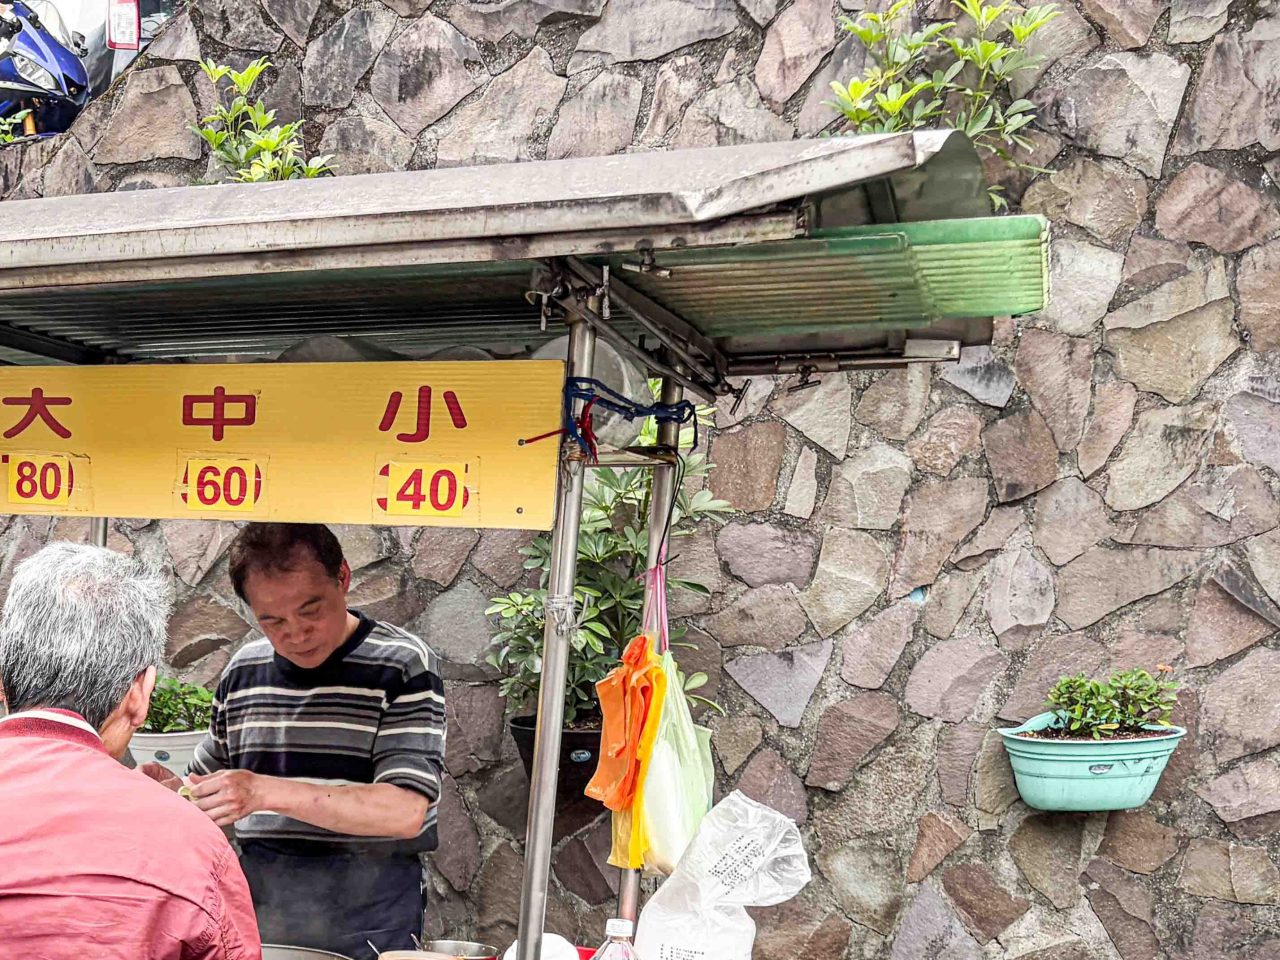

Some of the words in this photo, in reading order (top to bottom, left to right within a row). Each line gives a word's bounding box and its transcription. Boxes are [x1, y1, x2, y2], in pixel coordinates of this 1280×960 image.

[2, 386, 73, 439] 大
[182, 385, 257, 442] 中
[378, 385, 468, 443] 小
[16, 461, 62, 500] 80
[196, 465, 248, 506] 60
[396, 469, 458, 511] 40
